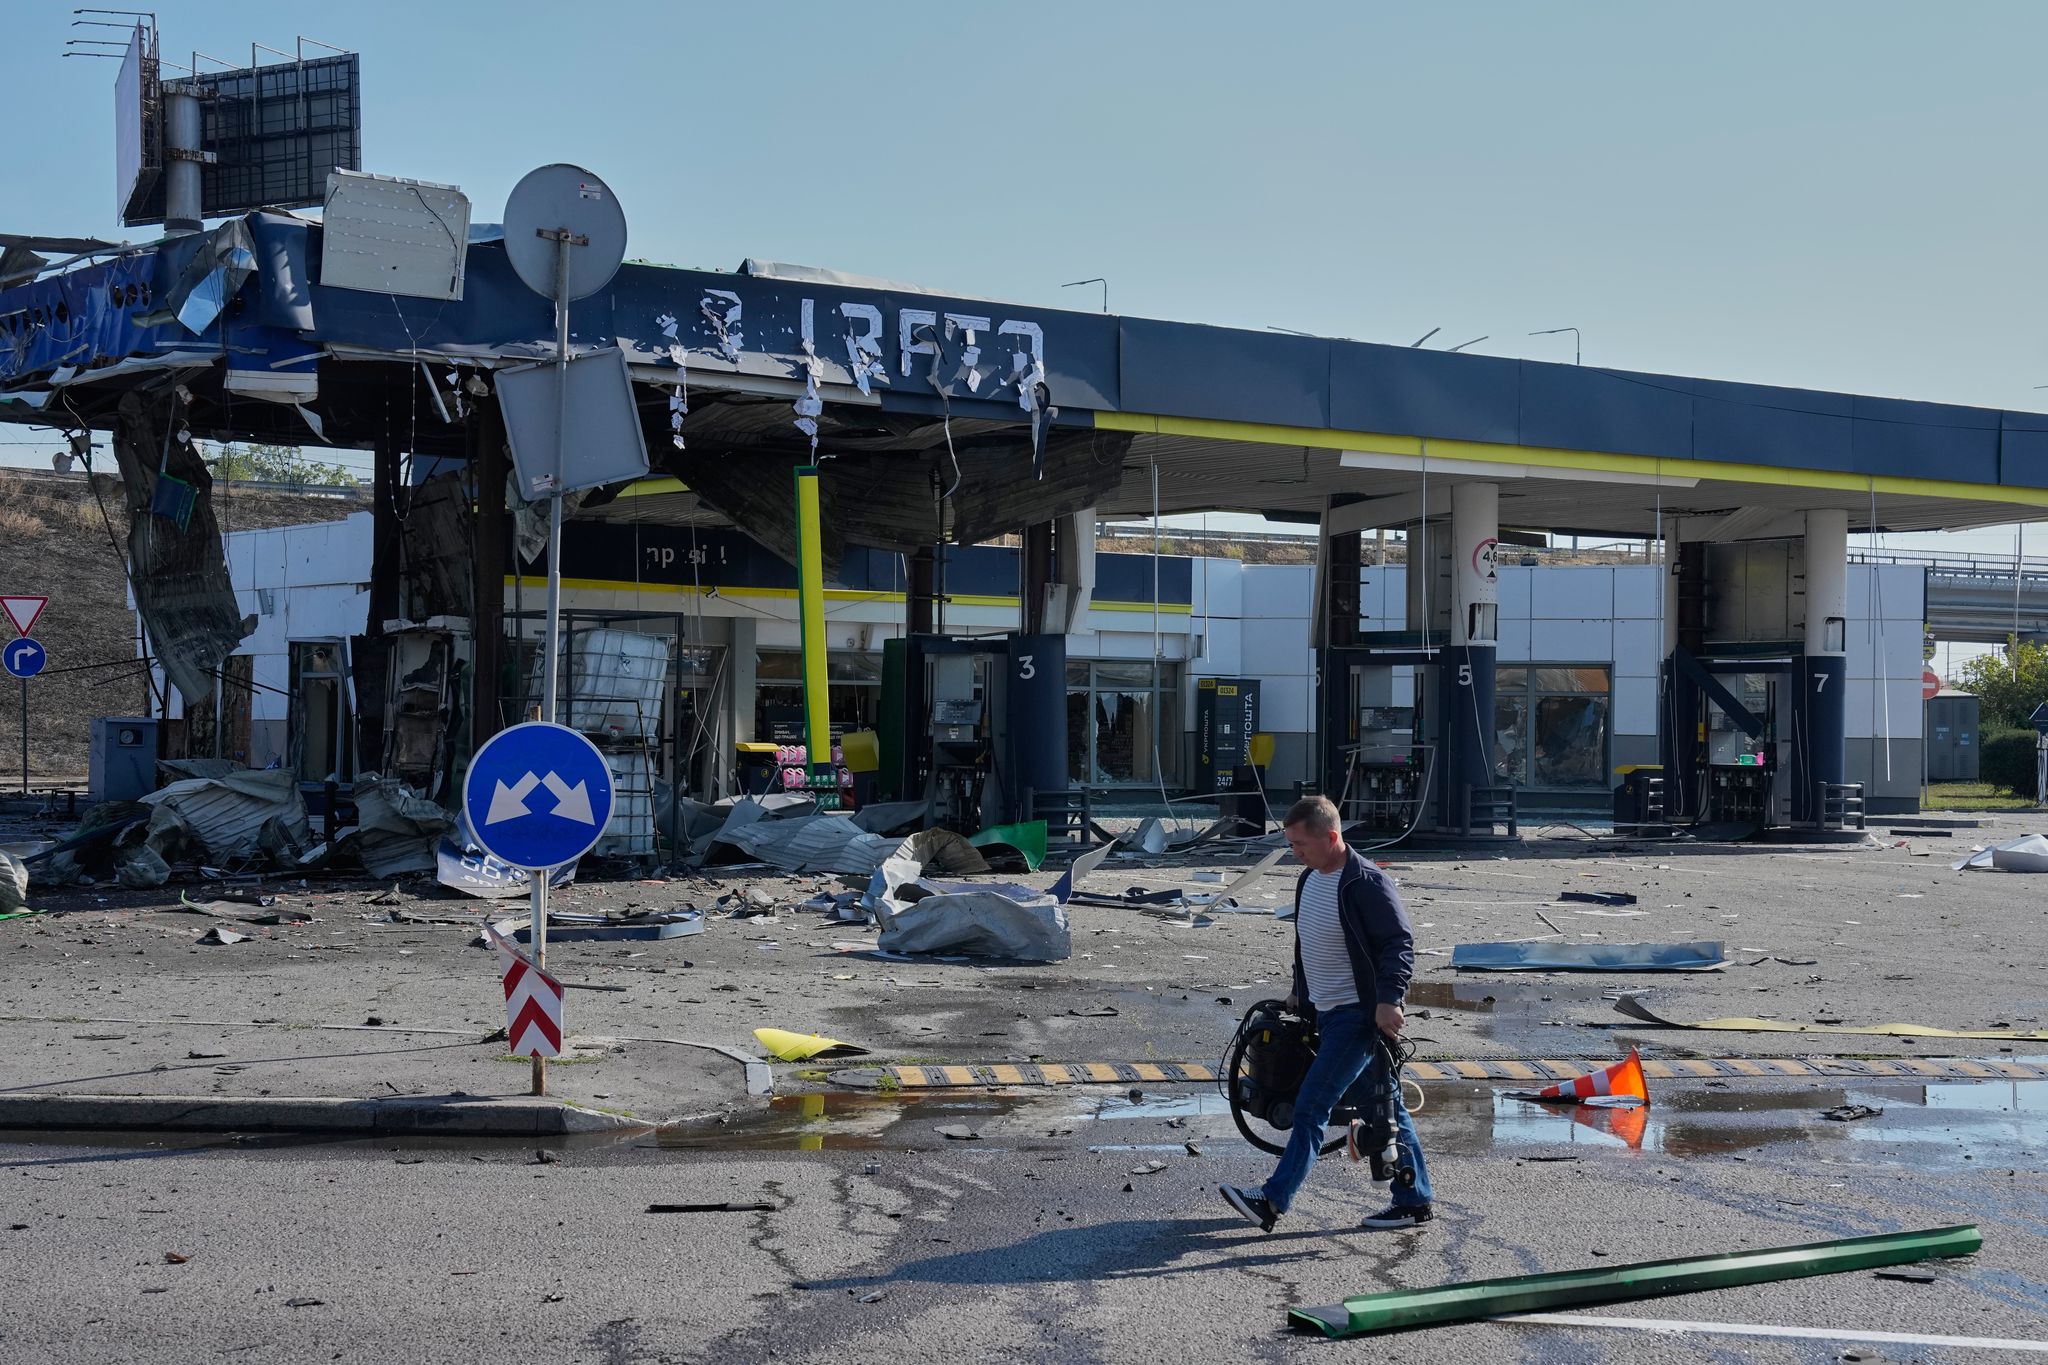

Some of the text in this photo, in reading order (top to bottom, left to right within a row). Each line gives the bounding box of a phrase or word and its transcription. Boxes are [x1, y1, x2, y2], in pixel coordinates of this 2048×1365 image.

[1018, 655, 1036, 680] 3
[1458, 664, 1473, 686] 5
[1813, 673, 1829, 693] 7
